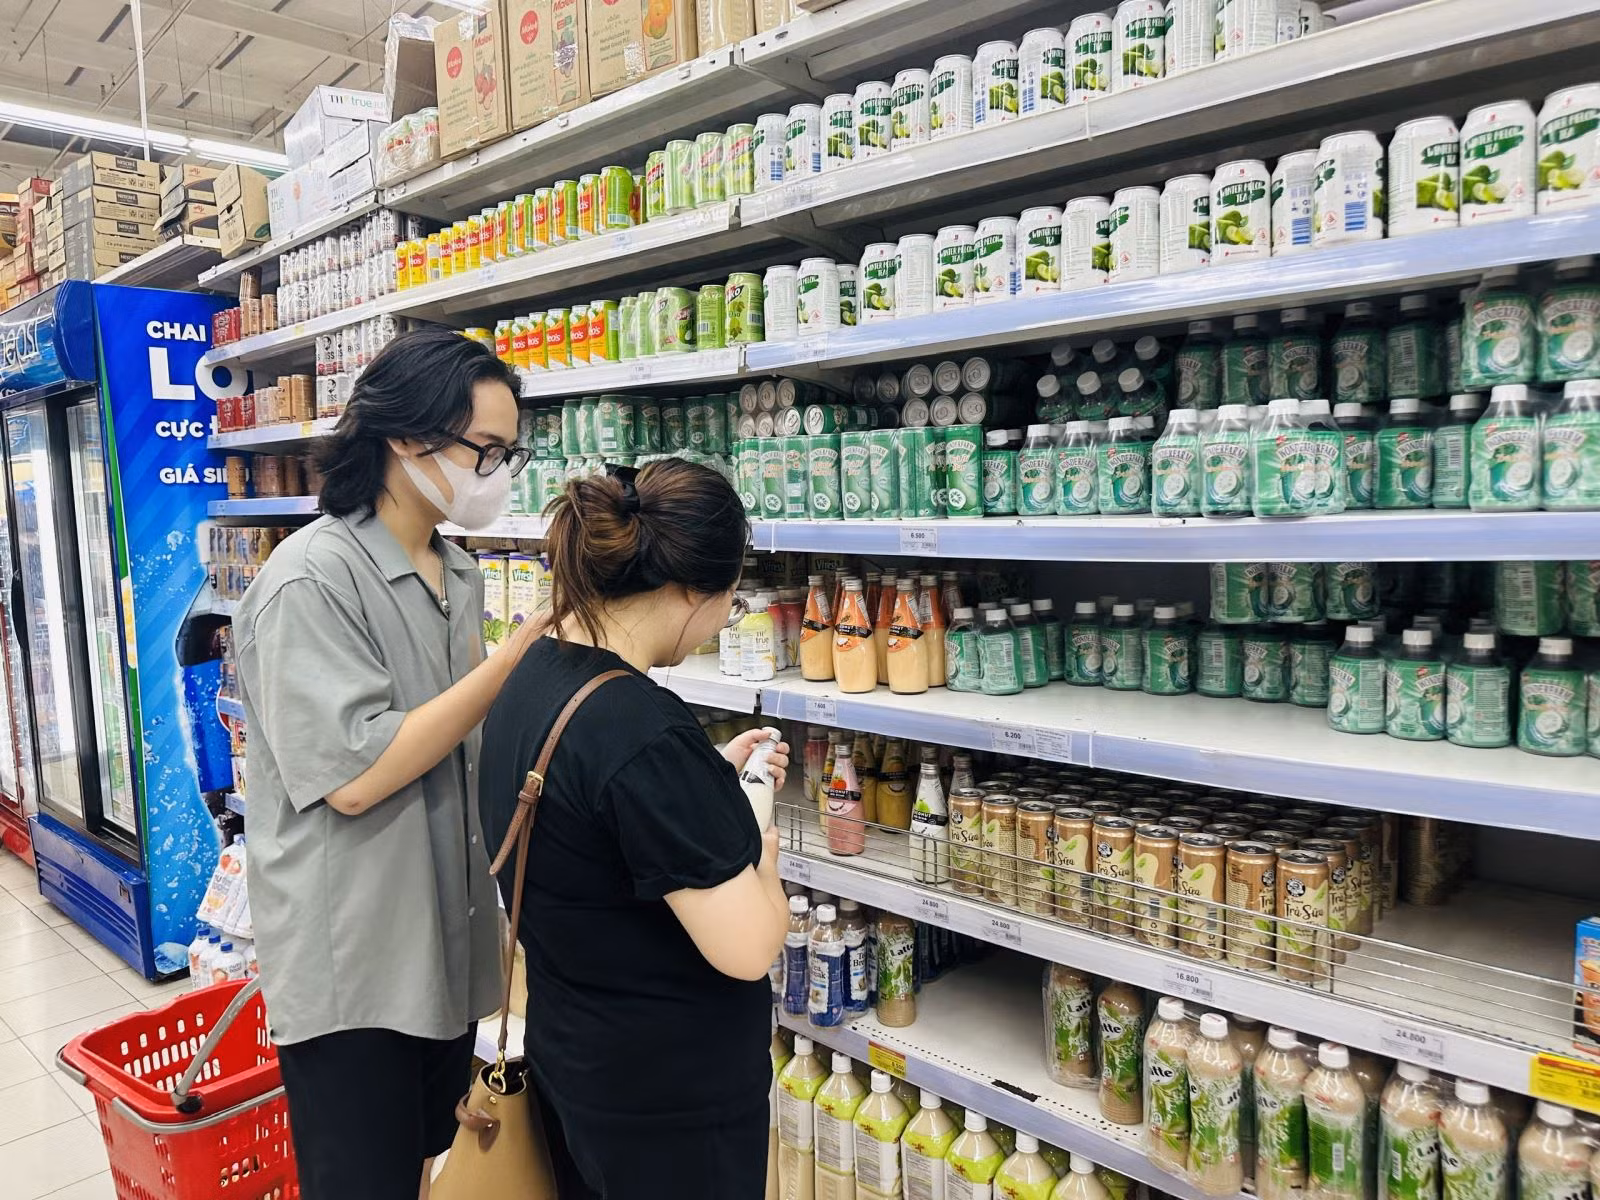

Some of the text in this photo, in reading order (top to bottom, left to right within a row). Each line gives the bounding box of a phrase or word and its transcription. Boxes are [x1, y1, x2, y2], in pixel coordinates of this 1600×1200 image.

[1484, 143, 1499, 155] TEA
[1236, 193, 1248, 203] TEA
[1045, 236, 1055, 245] TEA
[146, 320, 206, 342] CHAI
[155, 418, 204, 441] CỰC
[159, 462, 200, 484] GIÁ
[1176, 972, 1199, 984] 16.800
